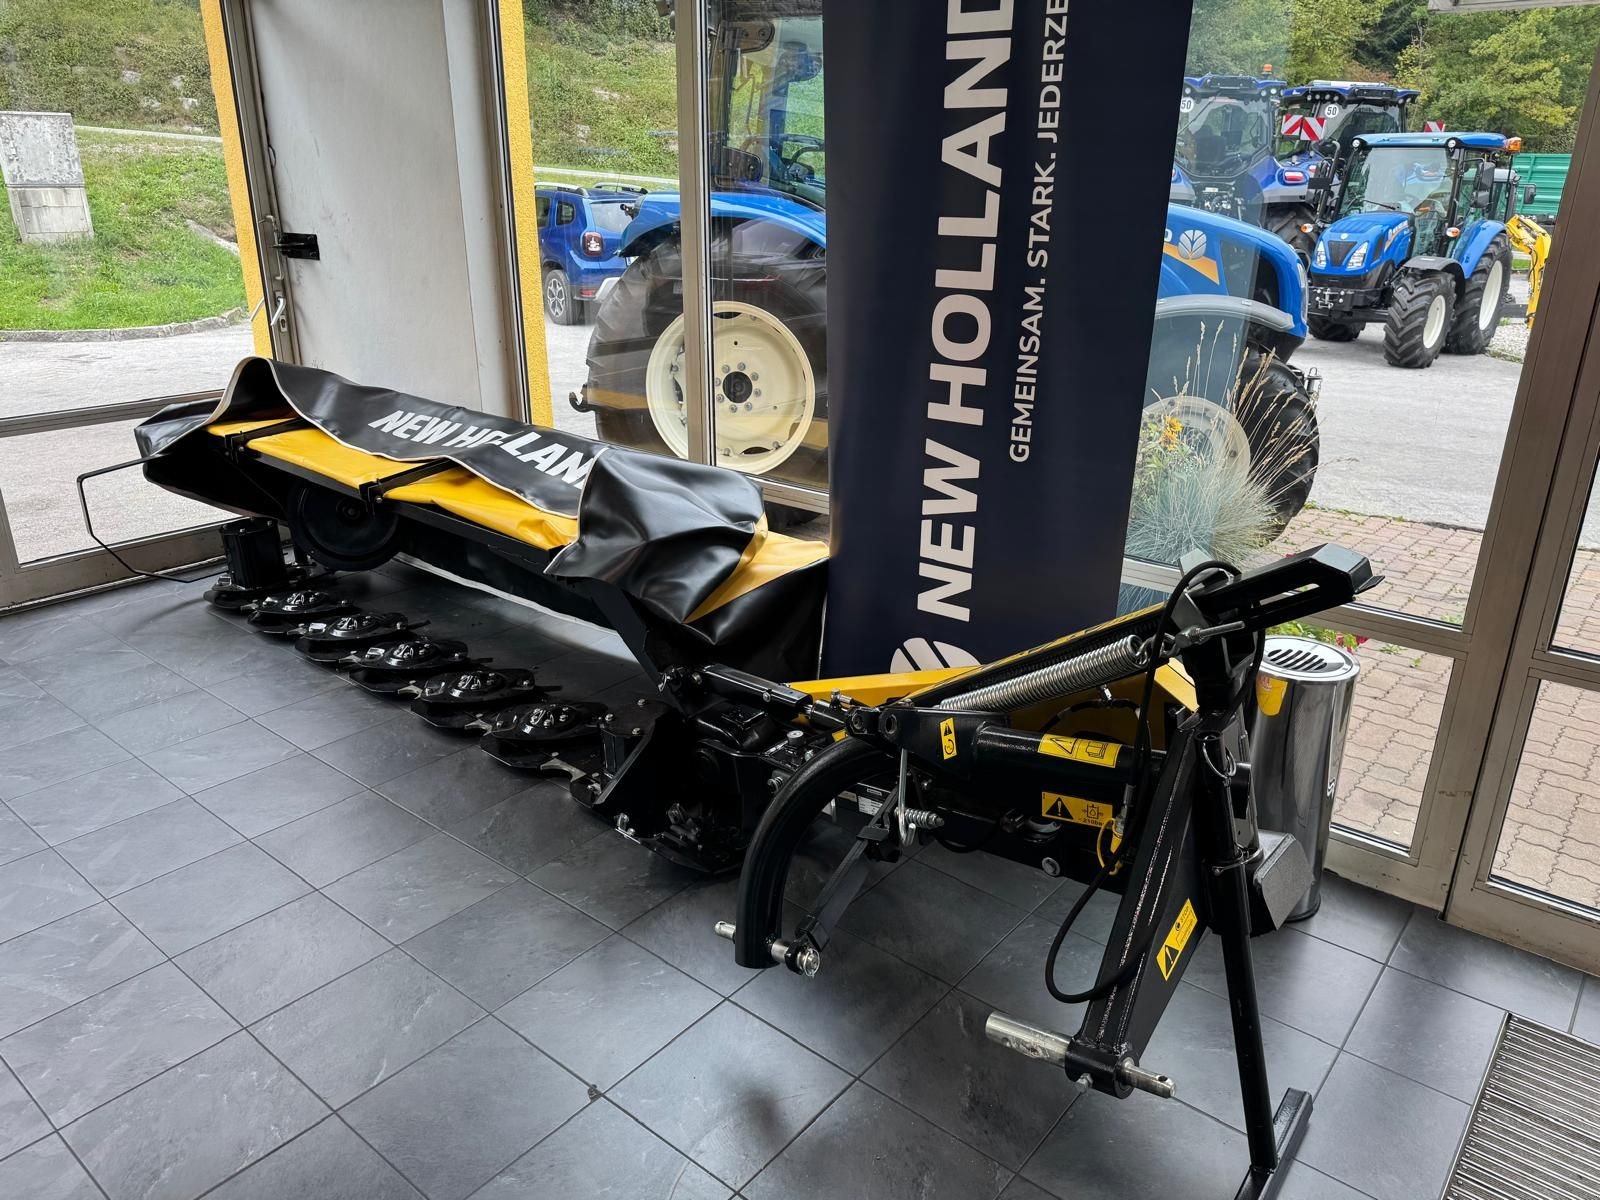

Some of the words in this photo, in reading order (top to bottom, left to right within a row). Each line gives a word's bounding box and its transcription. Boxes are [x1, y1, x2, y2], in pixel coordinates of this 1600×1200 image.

[1037, 0, 1069, 143] JEDERZE
[1180, 99, 1192, 110] 50
[1326, 106, 1338, 116] 50
[1026, 152, 1057, 268] STARK.
[367, 409, 463, 445] NEW
[1009, 278, 1046, 463] GEMEINSAM.
[917, 437, 981, 622] NEW
